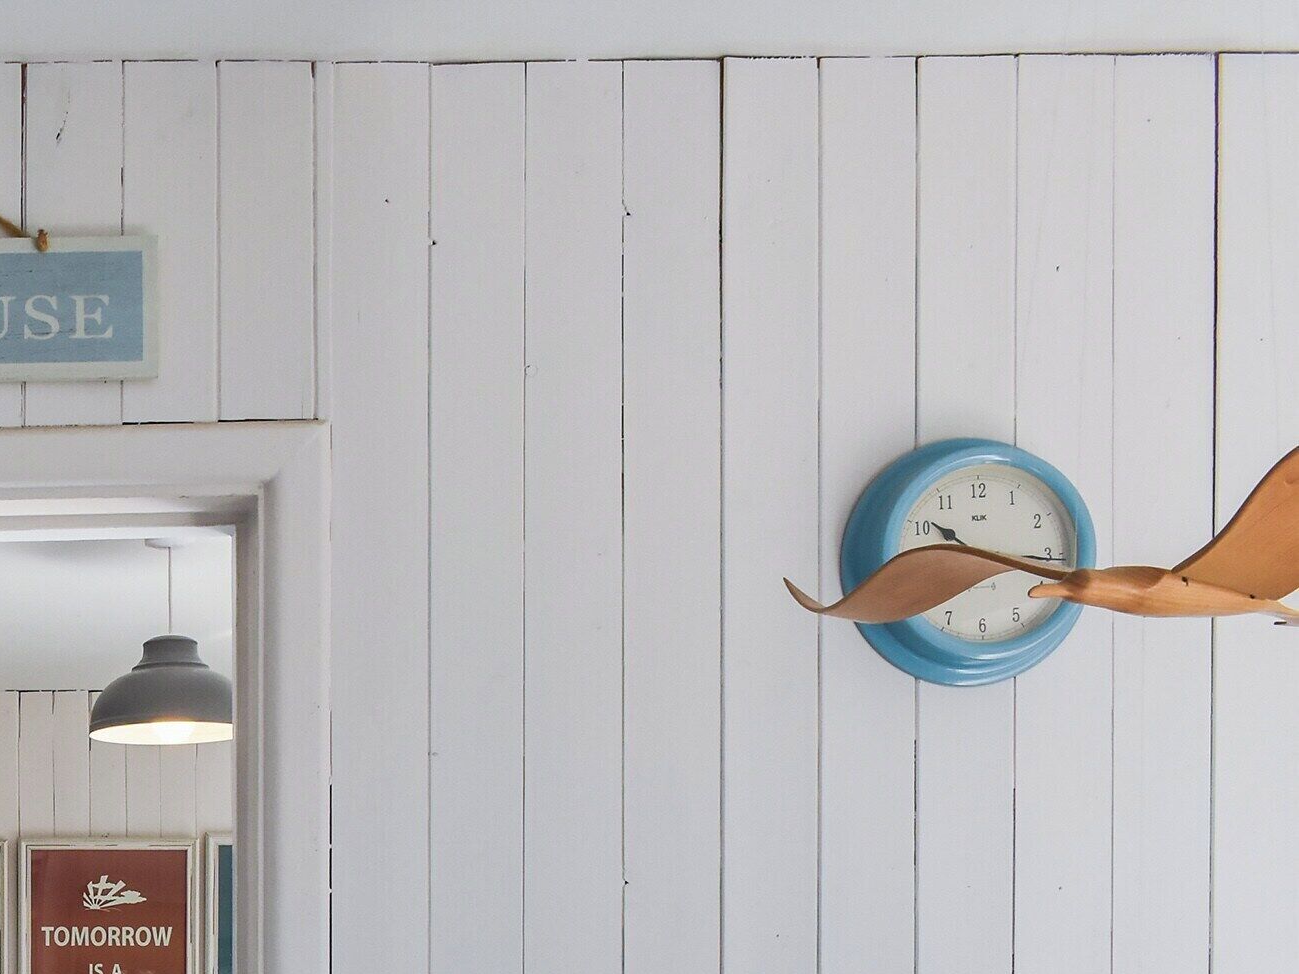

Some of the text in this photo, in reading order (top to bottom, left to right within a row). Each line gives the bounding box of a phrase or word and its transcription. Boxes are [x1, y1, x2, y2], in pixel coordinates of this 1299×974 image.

[971, 483, 986, 499] 12
[1009, 490, 1015, 506] 1
[939, 495, 953, 510] 11
[971, 514, 987, 522] KLIK
[1033, 513, 1042, 529] 2
[914, 520, 930, 536] 10
[1044, 547, 1052, 562] 3
[944, 610, 953, 626] 7
[1012, 607, 1020, 622] 5
[978, 617, 987, 633] 6
[41, 925, 173, 948] TOMORROW
